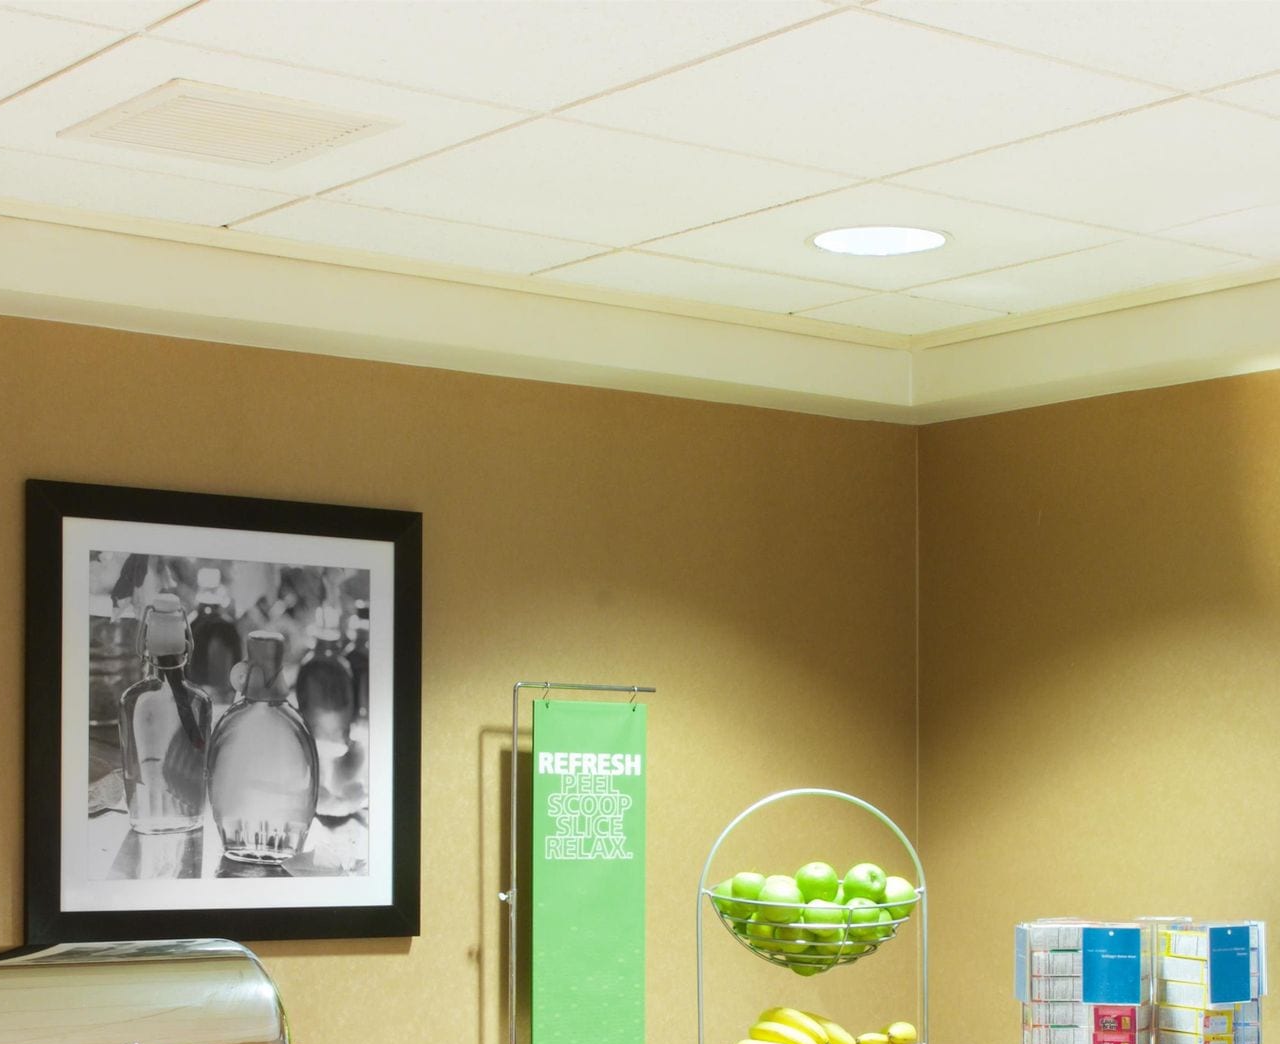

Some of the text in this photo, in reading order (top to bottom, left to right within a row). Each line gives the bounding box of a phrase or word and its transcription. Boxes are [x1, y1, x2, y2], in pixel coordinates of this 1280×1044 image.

[538, 752, 642, 776] REFRESH
[560, 771, 620, 796] PEEL
[547, 792, 633, 818] SCOOP
[555, 814, 625, 838] SLICE
[544, 835, 635, 860] RELAX.
